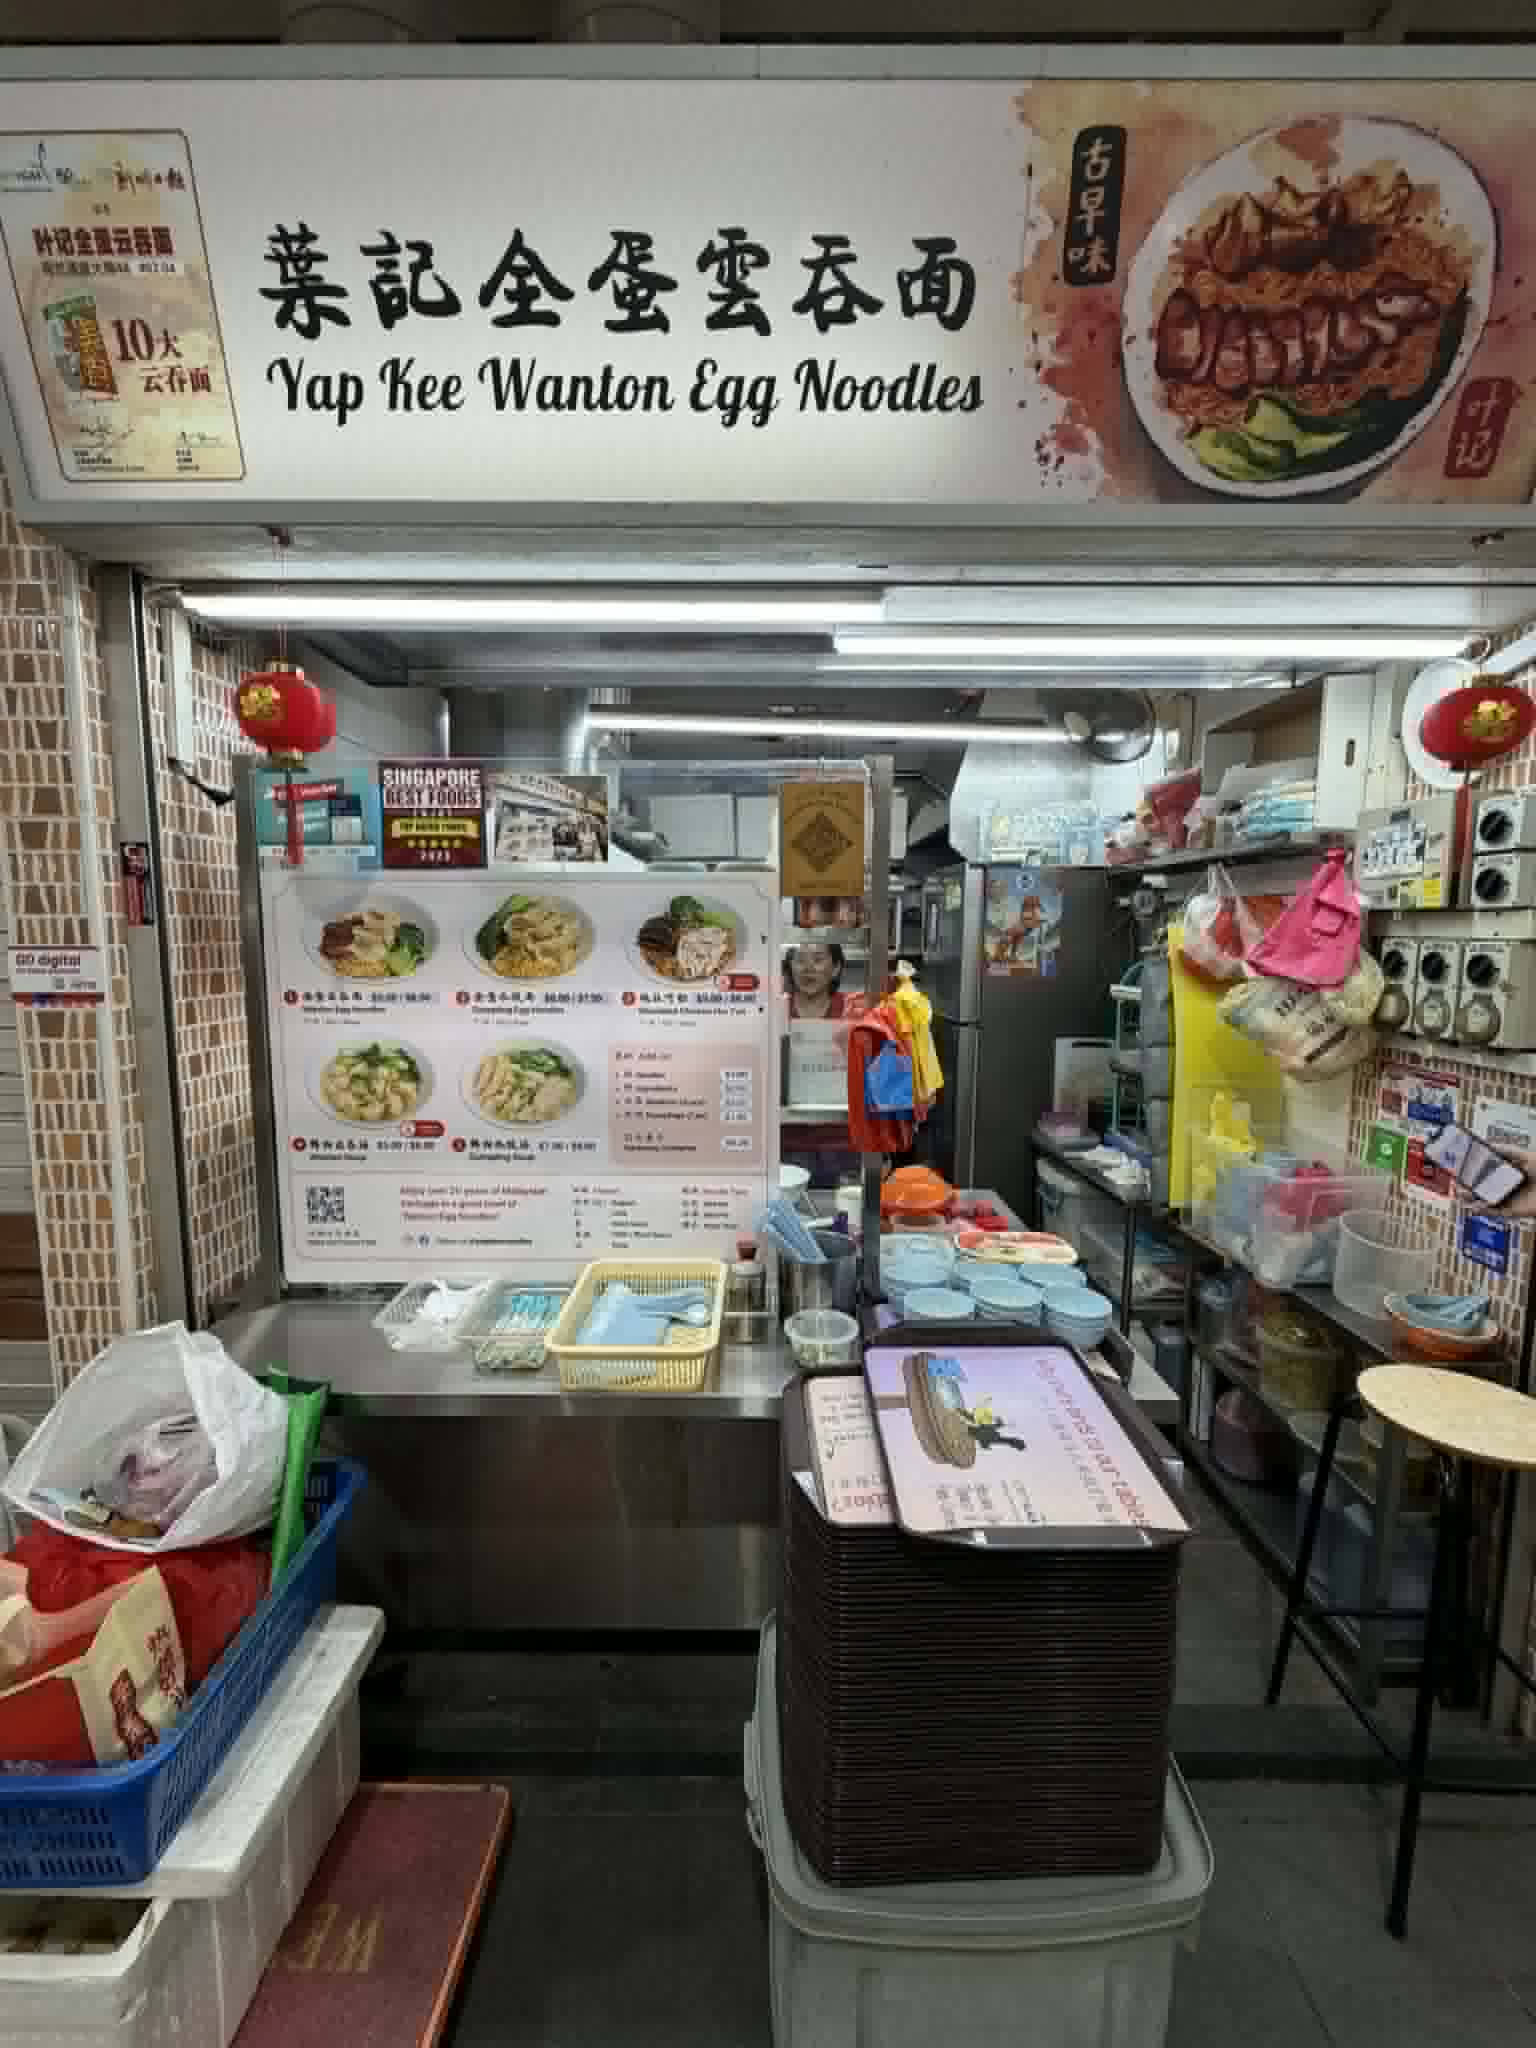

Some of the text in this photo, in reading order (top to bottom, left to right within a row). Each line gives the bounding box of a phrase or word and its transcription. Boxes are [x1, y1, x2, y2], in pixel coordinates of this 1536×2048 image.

[1067, 136, 1113, 273] 古早味
[258, 218, 977, 340] 葉記全蛋雲吞面
[266, 356, 985, 428] Yap Kee Wanton Egg Noodles
[383, 768, 481, 785] SINGAPORE
[385, 787, 479, 806] BEST FOODS
[38, 952, 81, 969] digital
